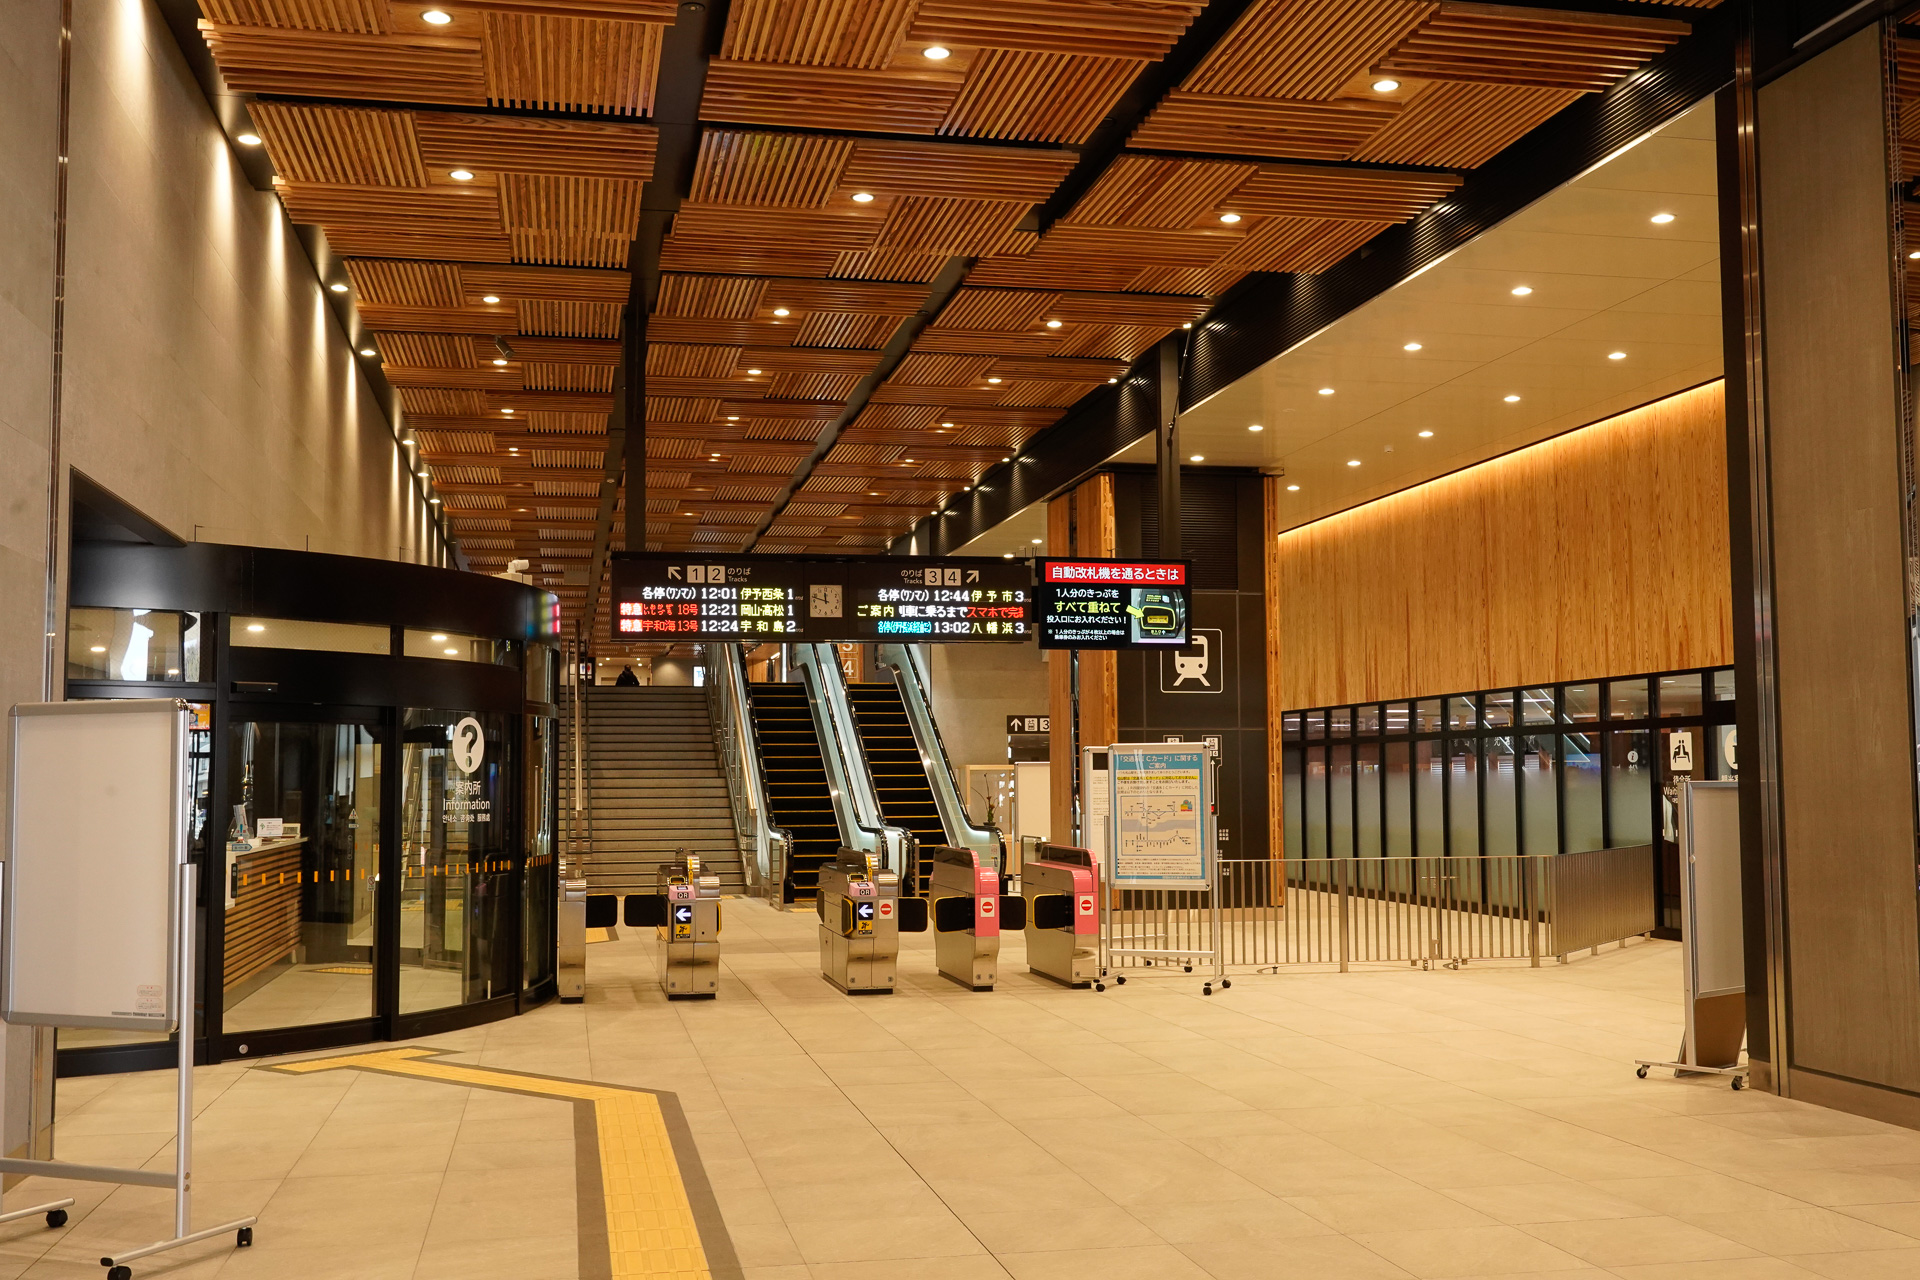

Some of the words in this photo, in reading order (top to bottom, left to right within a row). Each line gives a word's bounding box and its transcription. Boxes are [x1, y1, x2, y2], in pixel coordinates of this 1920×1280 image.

[692, 568, 699, 581] 1
[711, 568, 721, 581] 2
[727, 567, 751, 576] のりば
[928, 571, 938, 584] 3
[948, 571, 958, 584] 4
[1052, 566, 1179, 580] 自動改札機を通るときは
[701, 588, 738, 600] 12:01
[740, 588, 784, 600] 伊予西条
[934, 590, 970, 602] 12:44
[971, 590, 1013, 602] 伊予市
[1015, 590, 1024, 602] 3
[1056, 588, 1119, 598] 1人分のきっぷを
[678, 604, 698, 616] 18号
[701, 604, 738, 616] 12:21
[857, 605, 895, 617] ご案内
[1054, 601, 1121, 614] すべて重ねて
[701, 620, 739, 632] 12:24
[740, 620, 784, 633] 宇和島
[786, 620, 796, 632] 2
[934, 622, 970, 633] 13:02
[971, 622, 1014, 634] 八幡浜
[1015, 622, 1024, 634] 3
[843, 660, 854, 676] 4
[455, 781, 481, 795] 案内所
[443, 797, 490, 810] Information
